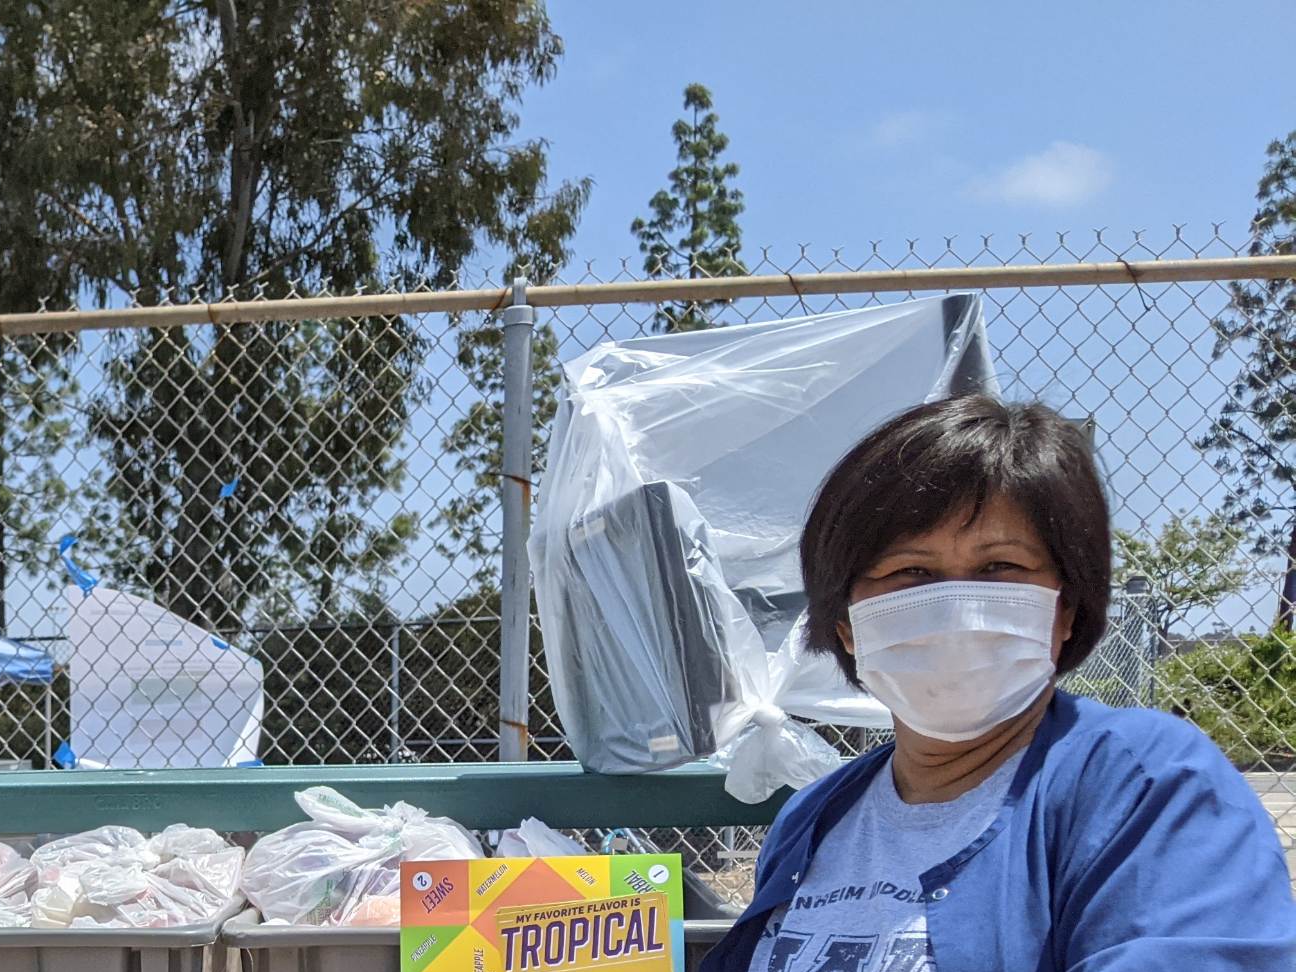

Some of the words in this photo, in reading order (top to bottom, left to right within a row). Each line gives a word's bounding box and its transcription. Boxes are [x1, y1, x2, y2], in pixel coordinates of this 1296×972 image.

[417, 875, 428, 887] 2
[476, 864, 509, 896] WATERMELON
[576, 868, 596, 886] MELON
[624, 870, 656, 894] RBAL
[422, 877, 454, 914] SWEET
[788, 886, 866, 911] NHEIM
[516, 914, 532, 924] MY
[534, 906, 584, 921] FAVORITE
[587, 900, 628, 913] FLAVOR
[631, 898, 641, 906] IS
[410, 935, 438, 962] PINEAPPLE
[501, 907, 664, 972] TROPICAL
